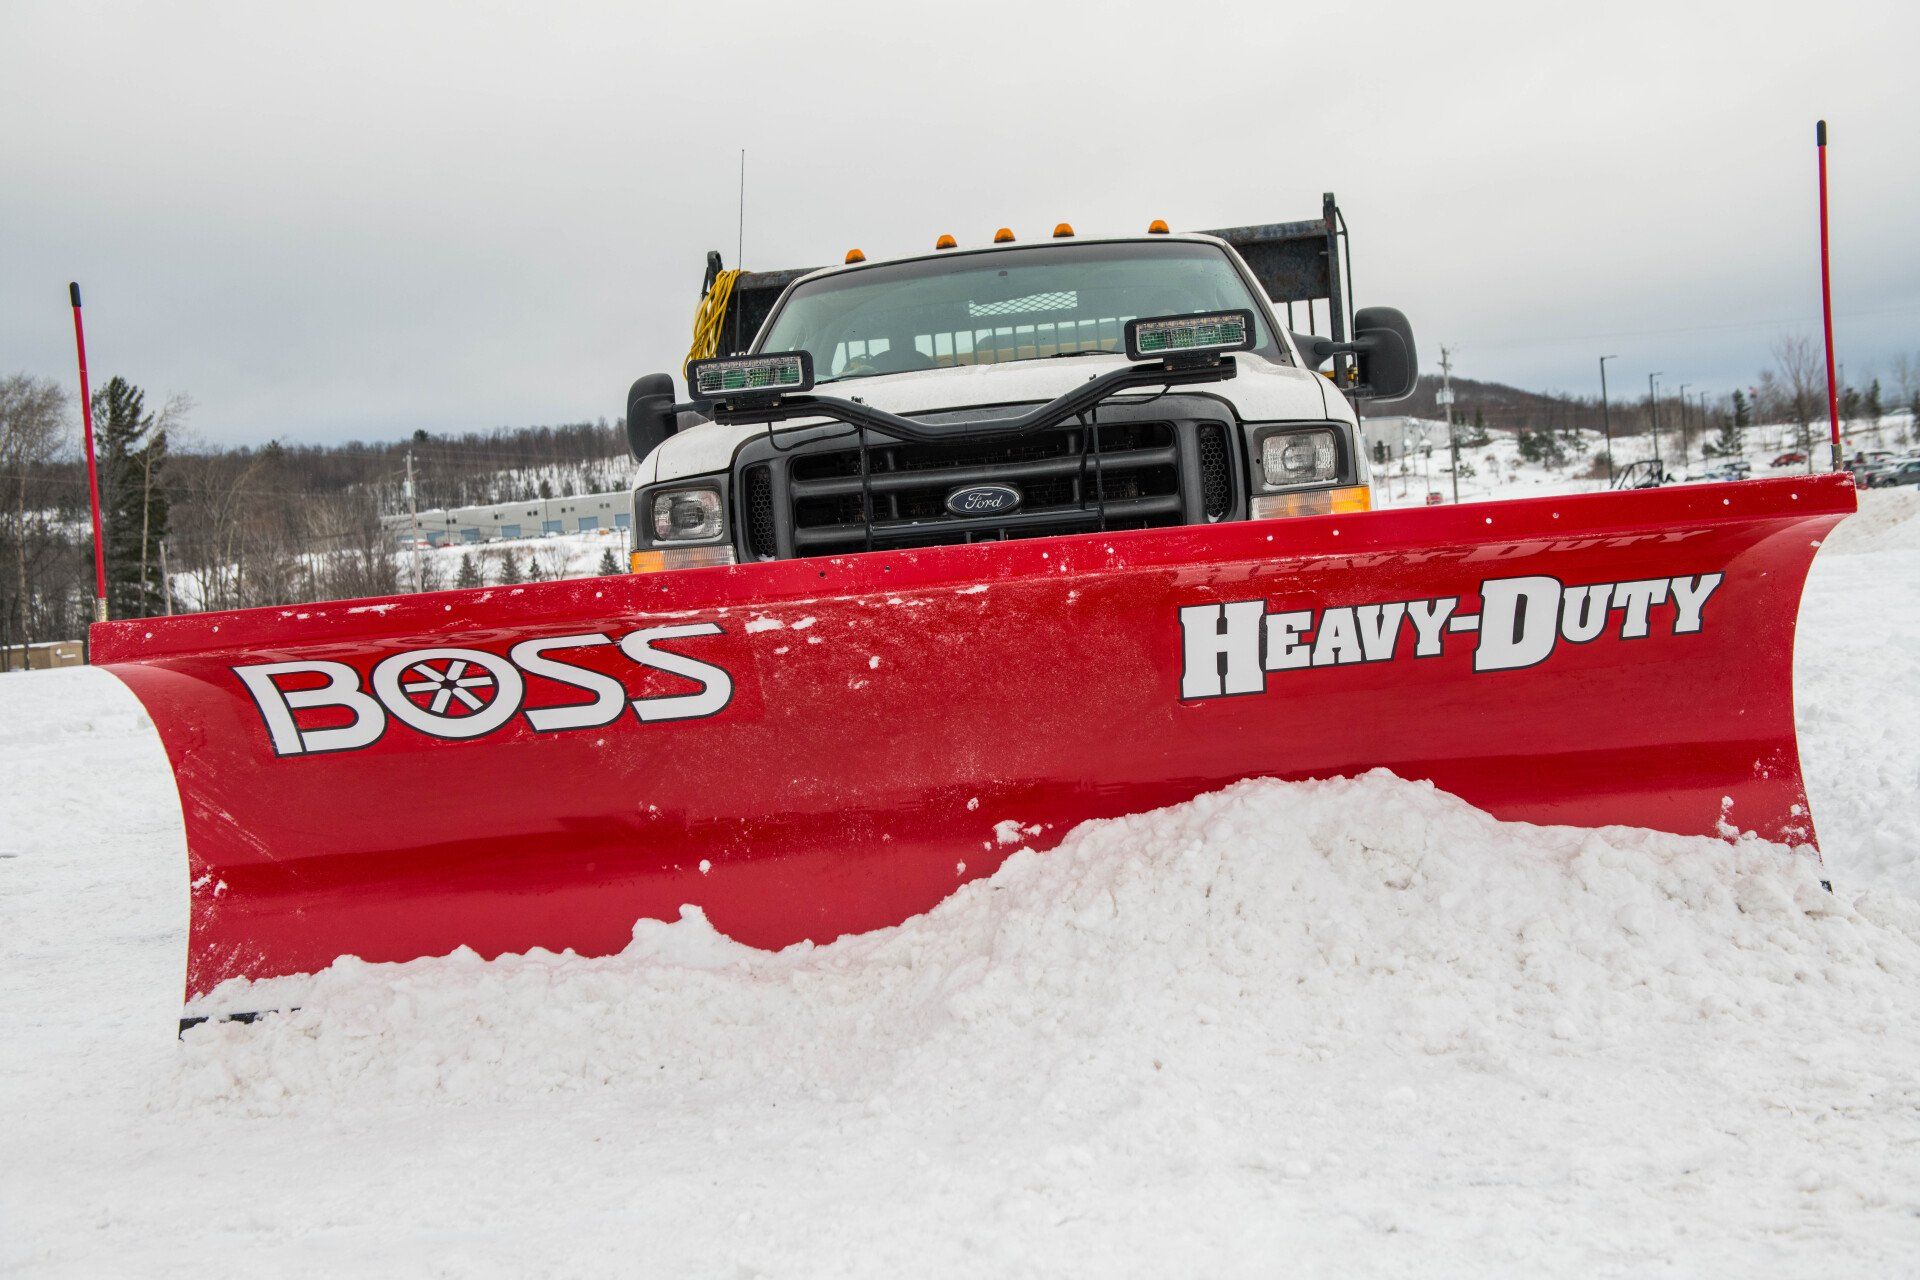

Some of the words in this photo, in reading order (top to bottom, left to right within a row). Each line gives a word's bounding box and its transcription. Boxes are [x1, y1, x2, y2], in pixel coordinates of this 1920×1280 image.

[964, 492, 1003, 510] Ford
[233, 622, 734, 756] BOSS
[1179, 571, 1725, 700] HEAVY-DUTY
